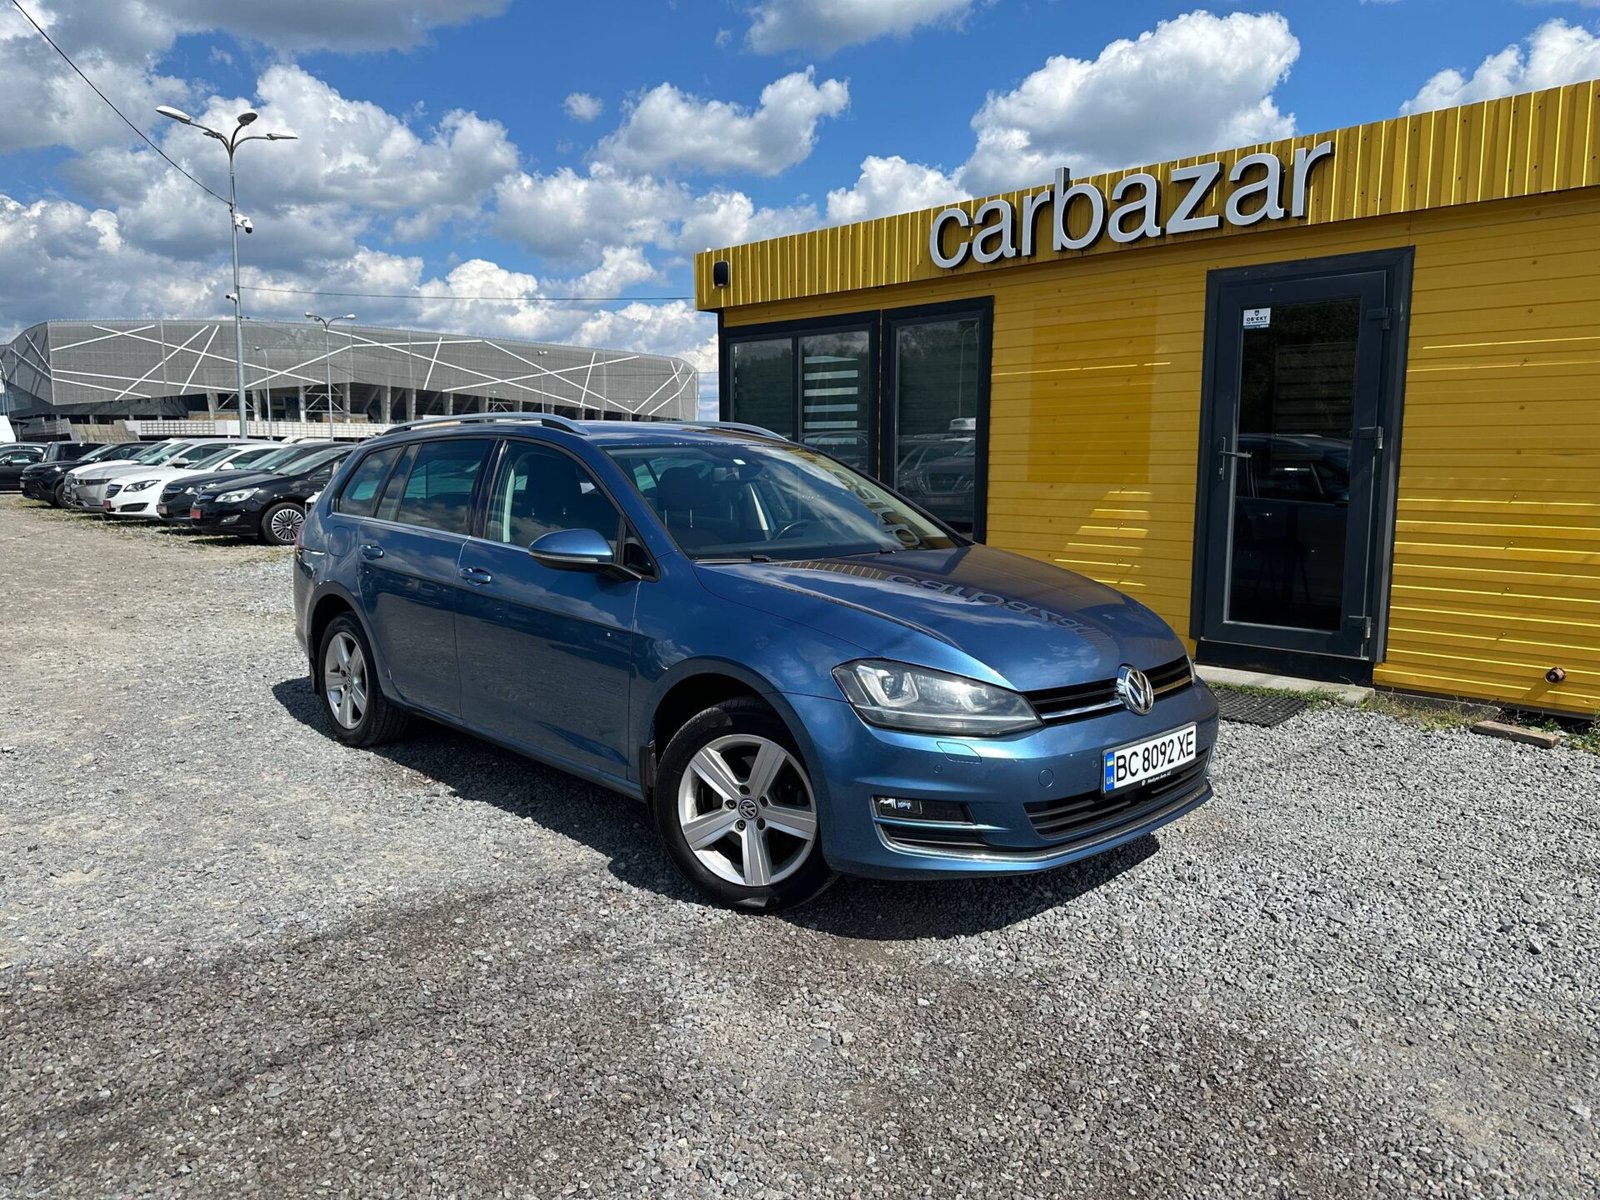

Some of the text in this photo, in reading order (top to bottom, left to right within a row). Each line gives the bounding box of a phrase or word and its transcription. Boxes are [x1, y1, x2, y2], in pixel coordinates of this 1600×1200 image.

[929, 140, 1335, 269] carbazar
[1106, 776, 1114, 785] UA
[1116, 751, 1139, 783] BC
[1142, 738, 1175, 773] 8092
[1177, 730, 1194, 761] XE
